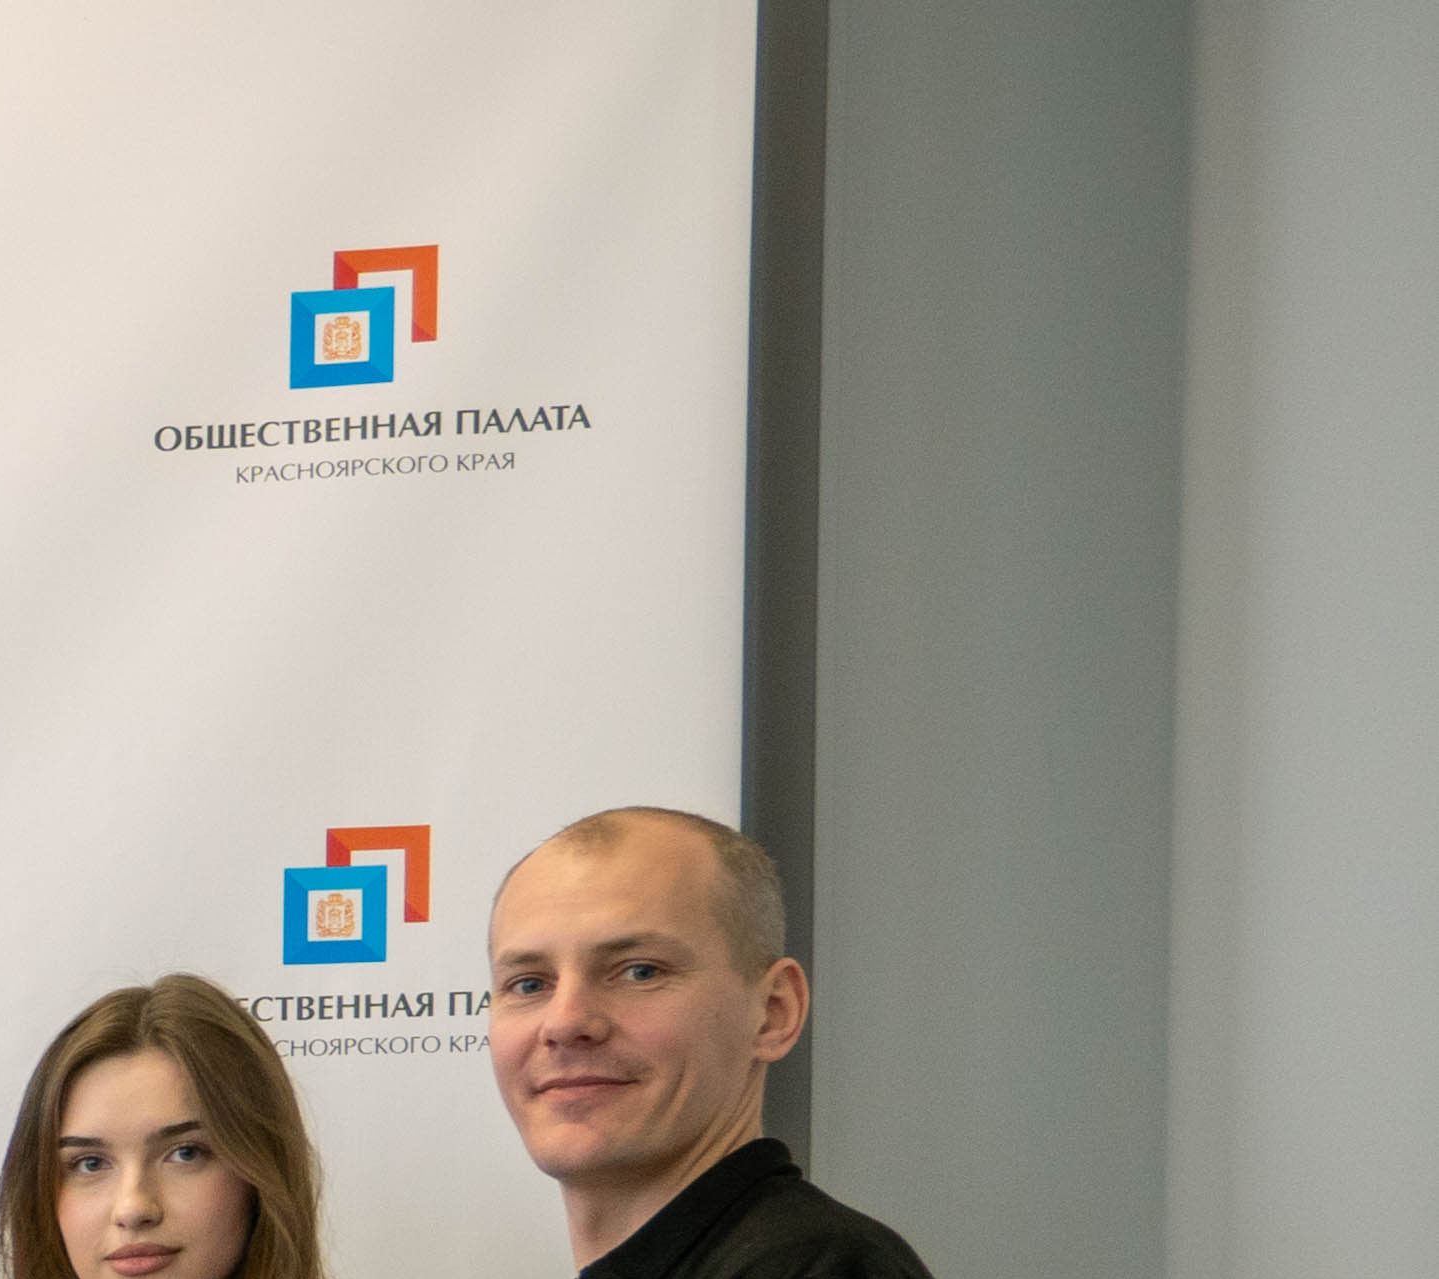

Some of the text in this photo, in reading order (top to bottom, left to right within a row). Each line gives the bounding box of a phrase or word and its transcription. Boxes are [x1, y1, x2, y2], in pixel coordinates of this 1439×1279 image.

[153, 404, 593, 452] ОБЩЕСТВЕННАЯ ПАЛАТА
[235, 452, 516, 485] КРАСНОЯРСКОГО КРАЯ
[276, 1034, 490, 1057] СНОЯРСКОГО КРА
